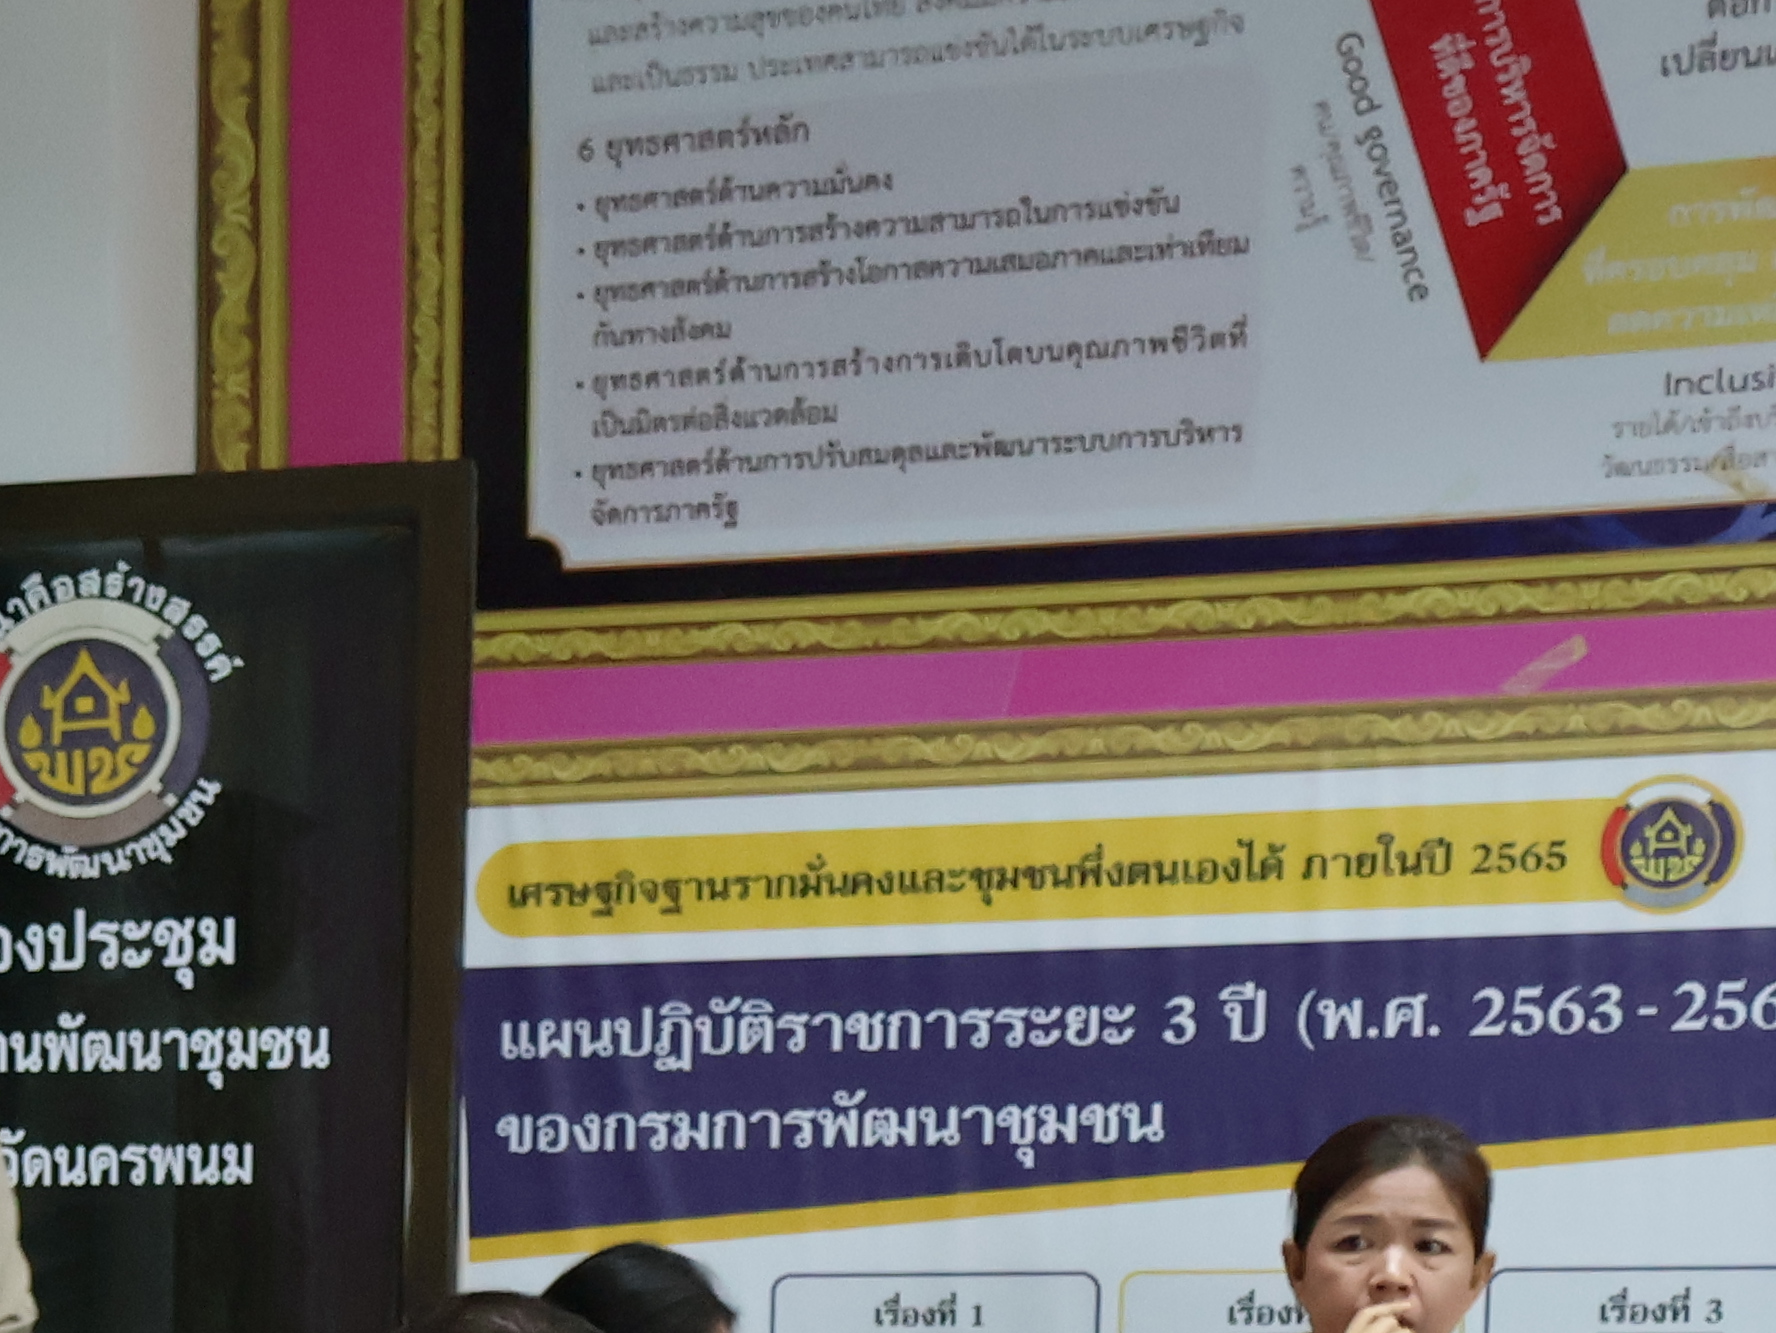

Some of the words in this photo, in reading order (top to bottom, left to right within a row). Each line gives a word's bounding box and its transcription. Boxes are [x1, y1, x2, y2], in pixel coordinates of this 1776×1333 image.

[1337, 31, 1383, 116] Good
[577, 138, 595, 163] 6
[605, 112, 810, 168] ยุทธศาสตร์หลัก
[595, 160, 894, 223] ยุทธศาสตร์ด้านความมั่นคง
[1354, 124, 1429, 302] governance
[505, 838, 1285, 918] เศรษฐกิจฐานรากมั่นคงและชุมชนพึ่งตนเองได้
[1301, 836, 1452, 886] ภายในปี
[1470, 839, 1567, 875] 2565
[499, 994, 1136, 1073] แผนปฏิบัติราชการระยะ
[1161, 995, 1198, 1046] 3
[1225, 981, 1268, 1044] ปี
[1297, 988, 1441, 1051] (พ.ศ.
[1468, 982, 1623, 1037] 2563
[496, 1089, 1166, 1168] ของกรมการพัฒนาชุมชน
[875, 1291, 958, 1328] เรื่องที่
[972, 1304, 986, 1327] 1
[1599, 1287, 1691, 1325] เรื่องที่
[1704, 1298, 1724, 1324] 3
